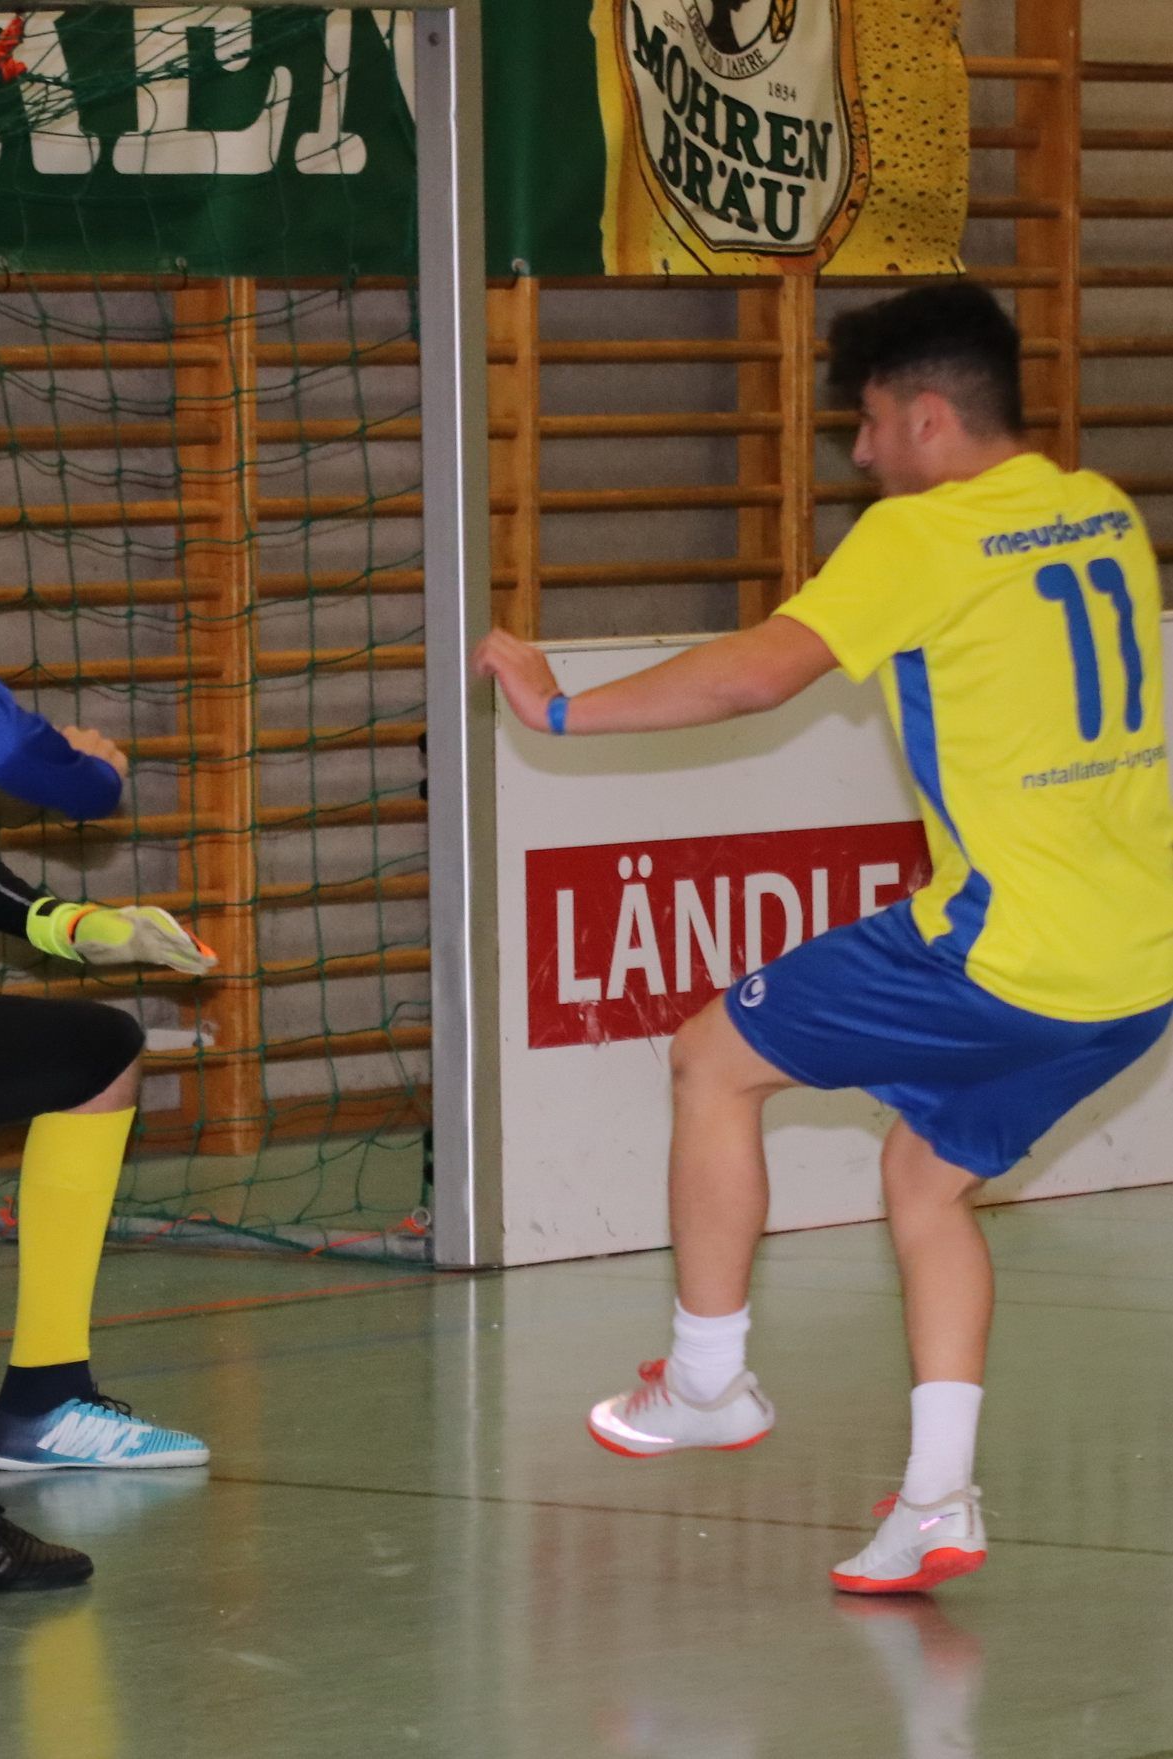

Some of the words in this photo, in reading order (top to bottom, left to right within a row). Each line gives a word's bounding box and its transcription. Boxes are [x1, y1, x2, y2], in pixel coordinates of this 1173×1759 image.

[630, 2, 832, 182] MOHREN
[767, 80, 797, 102] 1834
[659, 110, 806, 242] BRÄU
[1034, 556, 1144, 742] 11
